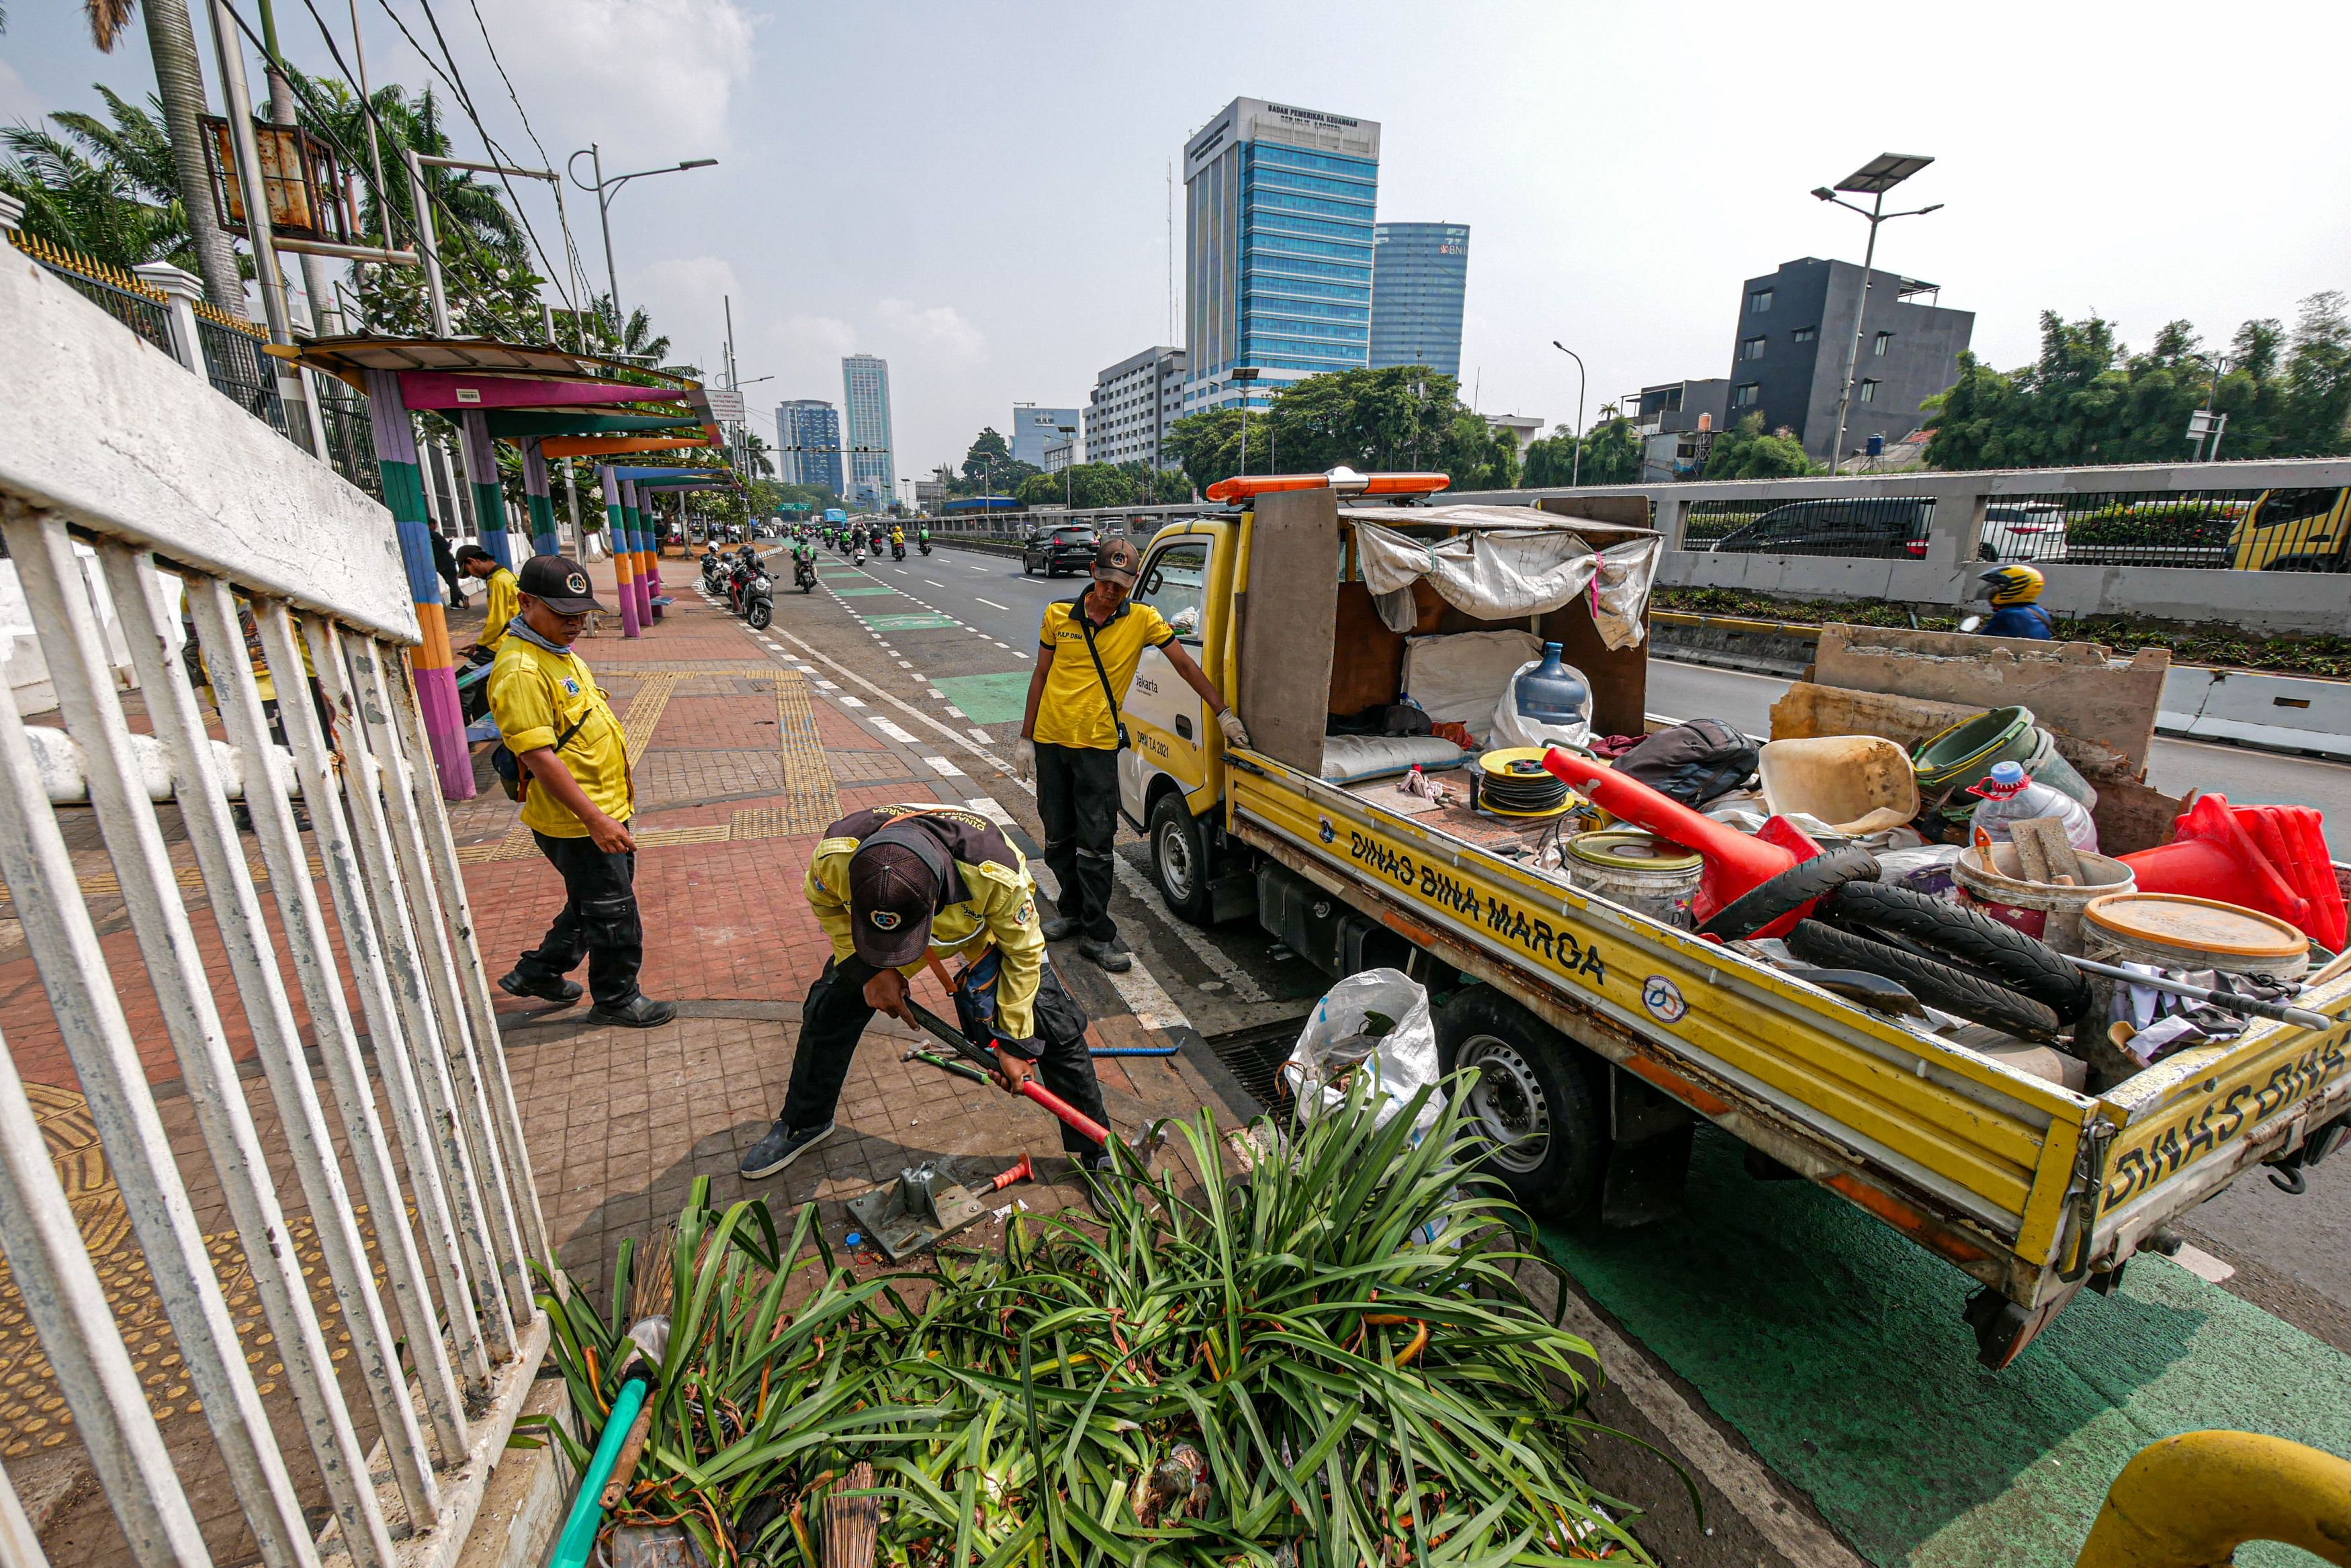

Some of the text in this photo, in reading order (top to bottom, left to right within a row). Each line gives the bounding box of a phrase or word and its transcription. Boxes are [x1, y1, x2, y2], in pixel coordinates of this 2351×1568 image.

[1268, 104, 1358, 128] BADAN PEMERIKSA KEUANGAN
[1449, 245, 1466, 255] BNI
[1070, 633, 1083, 641] DBM
[1157, 741, 1169, 758] 2021
[873, 808, 987, 832] DINAS ARGA
[1351, 830, 1605, 986] DINAS BINA MARGA
[2102, 1085, 2252, 1213] DINAS
